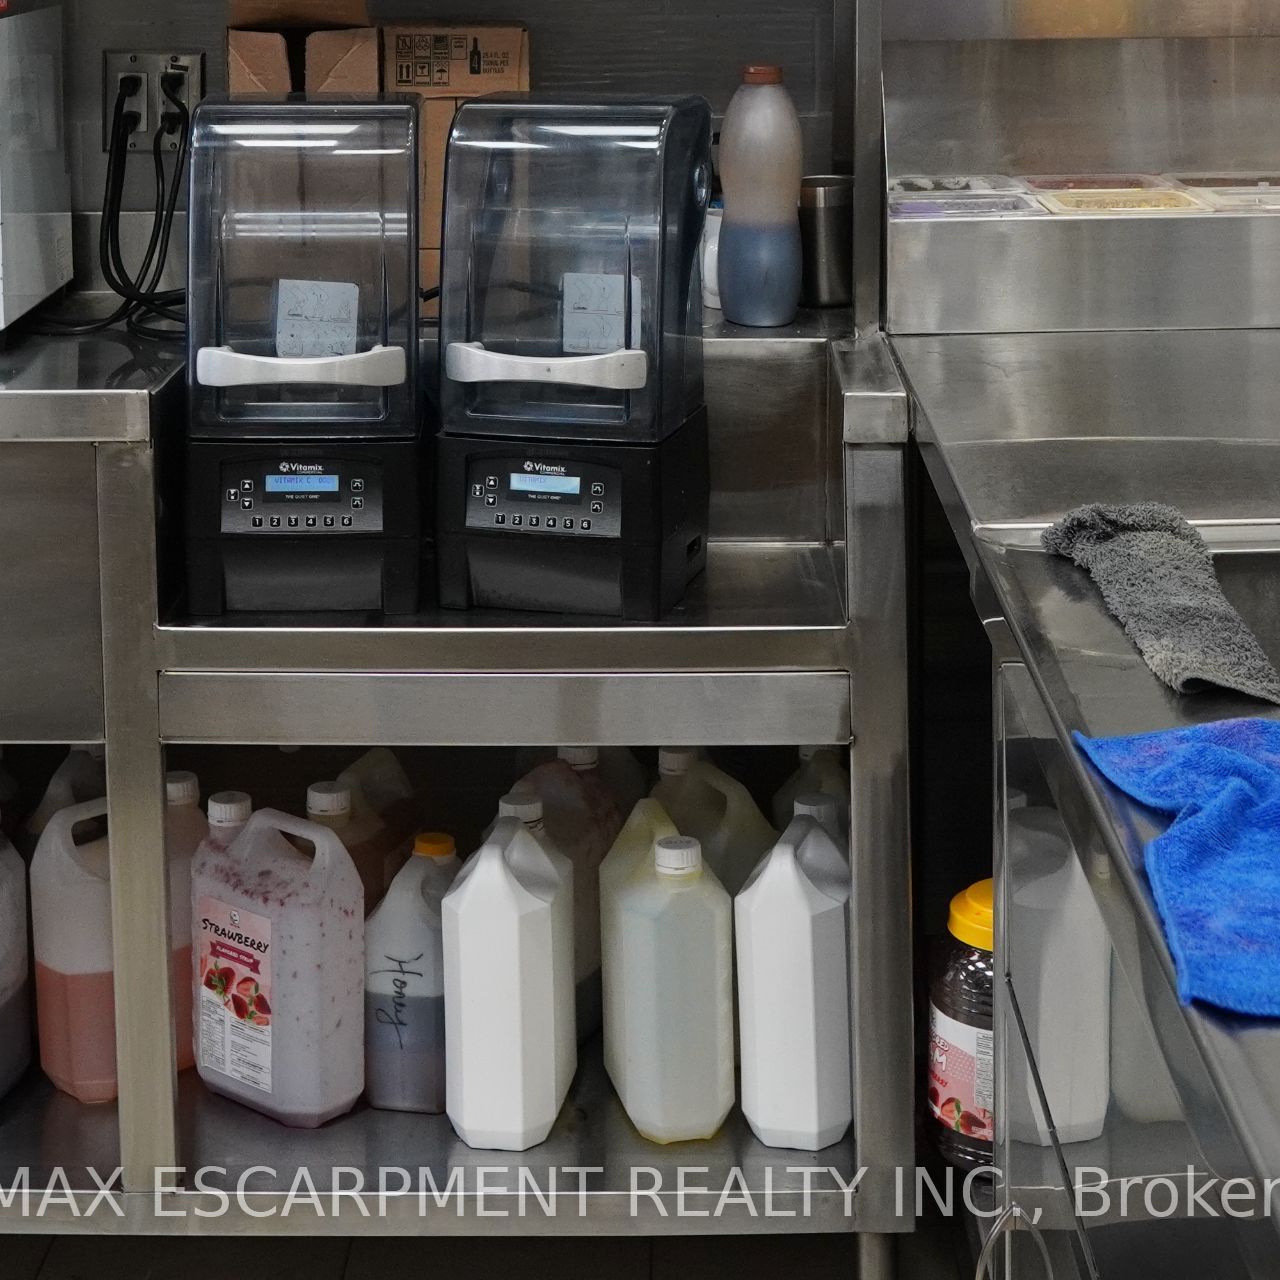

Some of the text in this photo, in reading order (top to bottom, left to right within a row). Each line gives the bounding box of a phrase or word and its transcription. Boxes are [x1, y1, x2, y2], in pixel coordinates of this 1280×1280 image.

[290, 462, 323, 471] Vitamix
[533, 462, 567, 473] Vitamix
[202, 918, 270, 954] STRAWBERRY
[369, 953, 424, 1050] Honey
